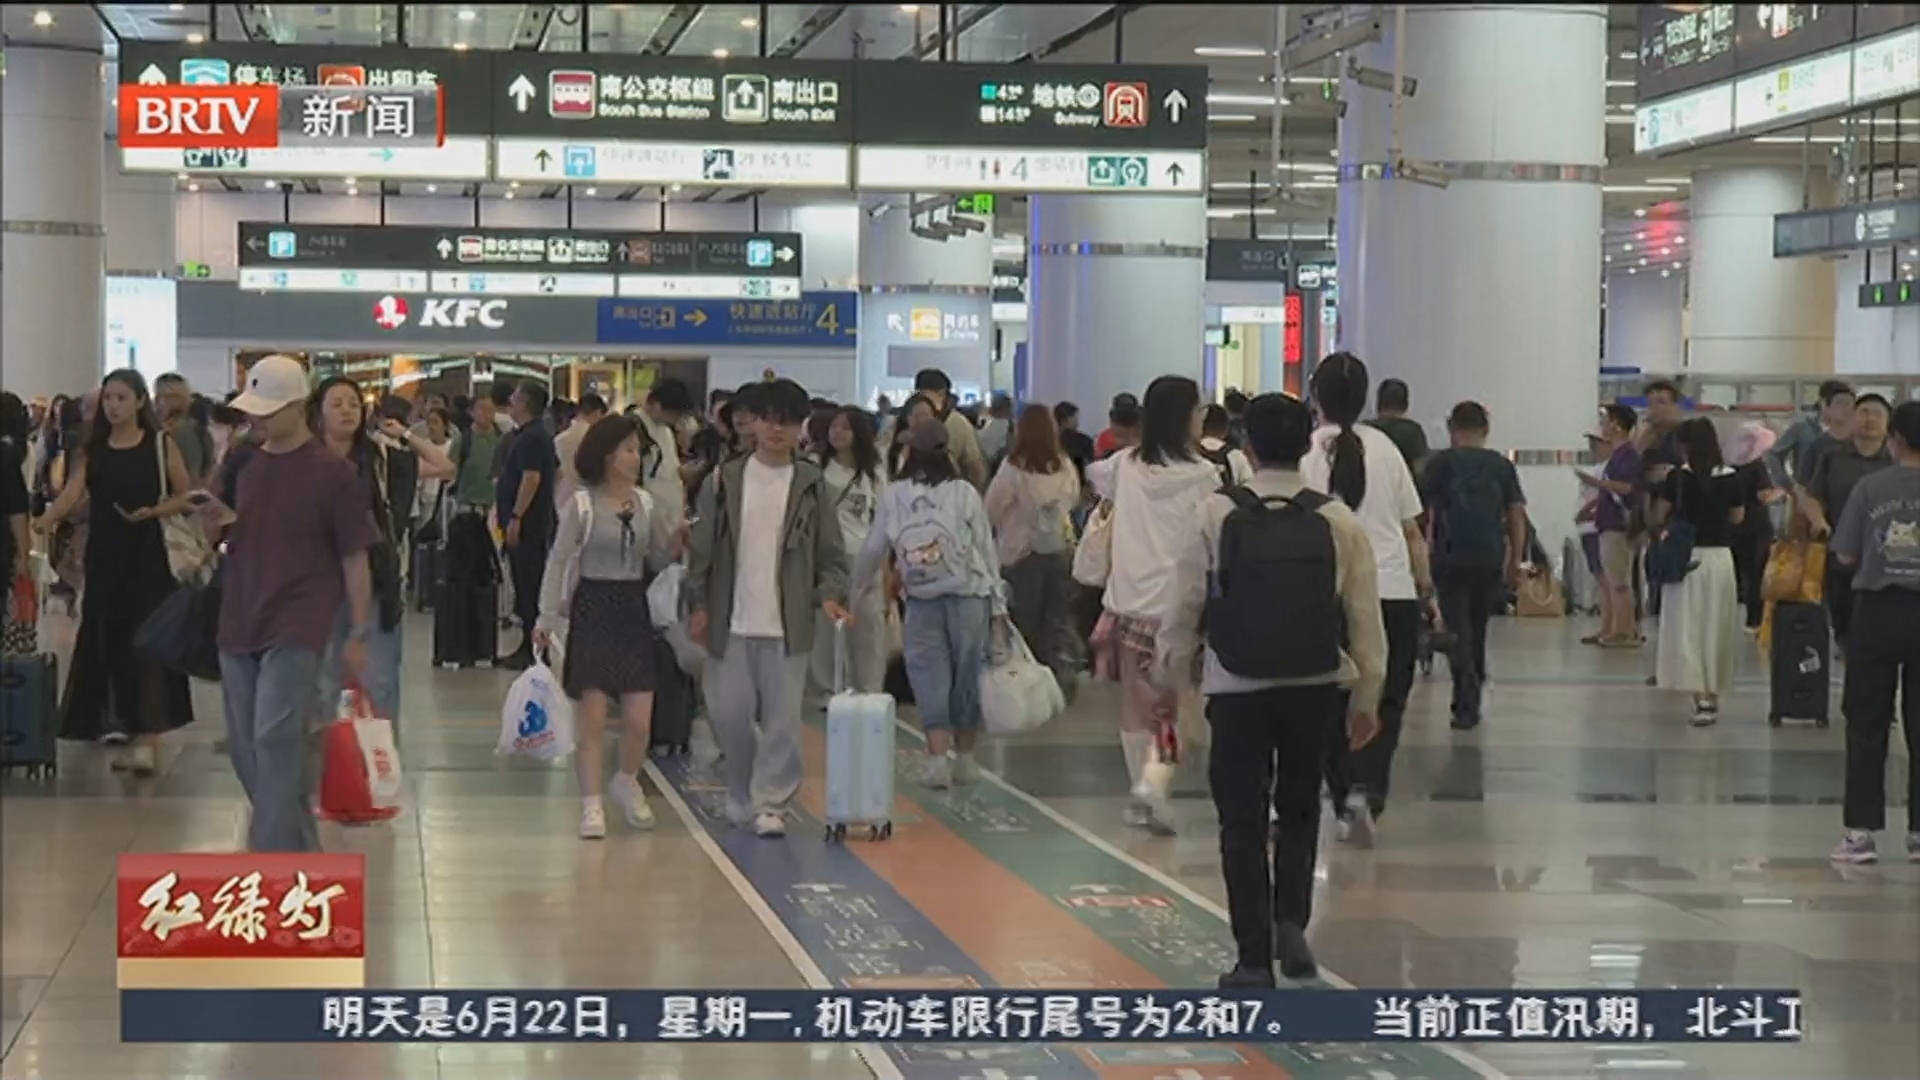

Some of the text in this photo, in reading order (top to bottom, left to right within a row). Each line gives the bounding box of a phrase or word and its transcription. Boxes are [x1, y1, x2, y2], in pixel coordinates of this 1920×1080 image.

[600, 75, 715, 100] 南公交枢纽
[772, 78, 839, 104] 南出口
[1032, 83, 1077, 107] 地铁
[418, 298, 508, 328] KFC
[815, 303, 840, 337] 4
